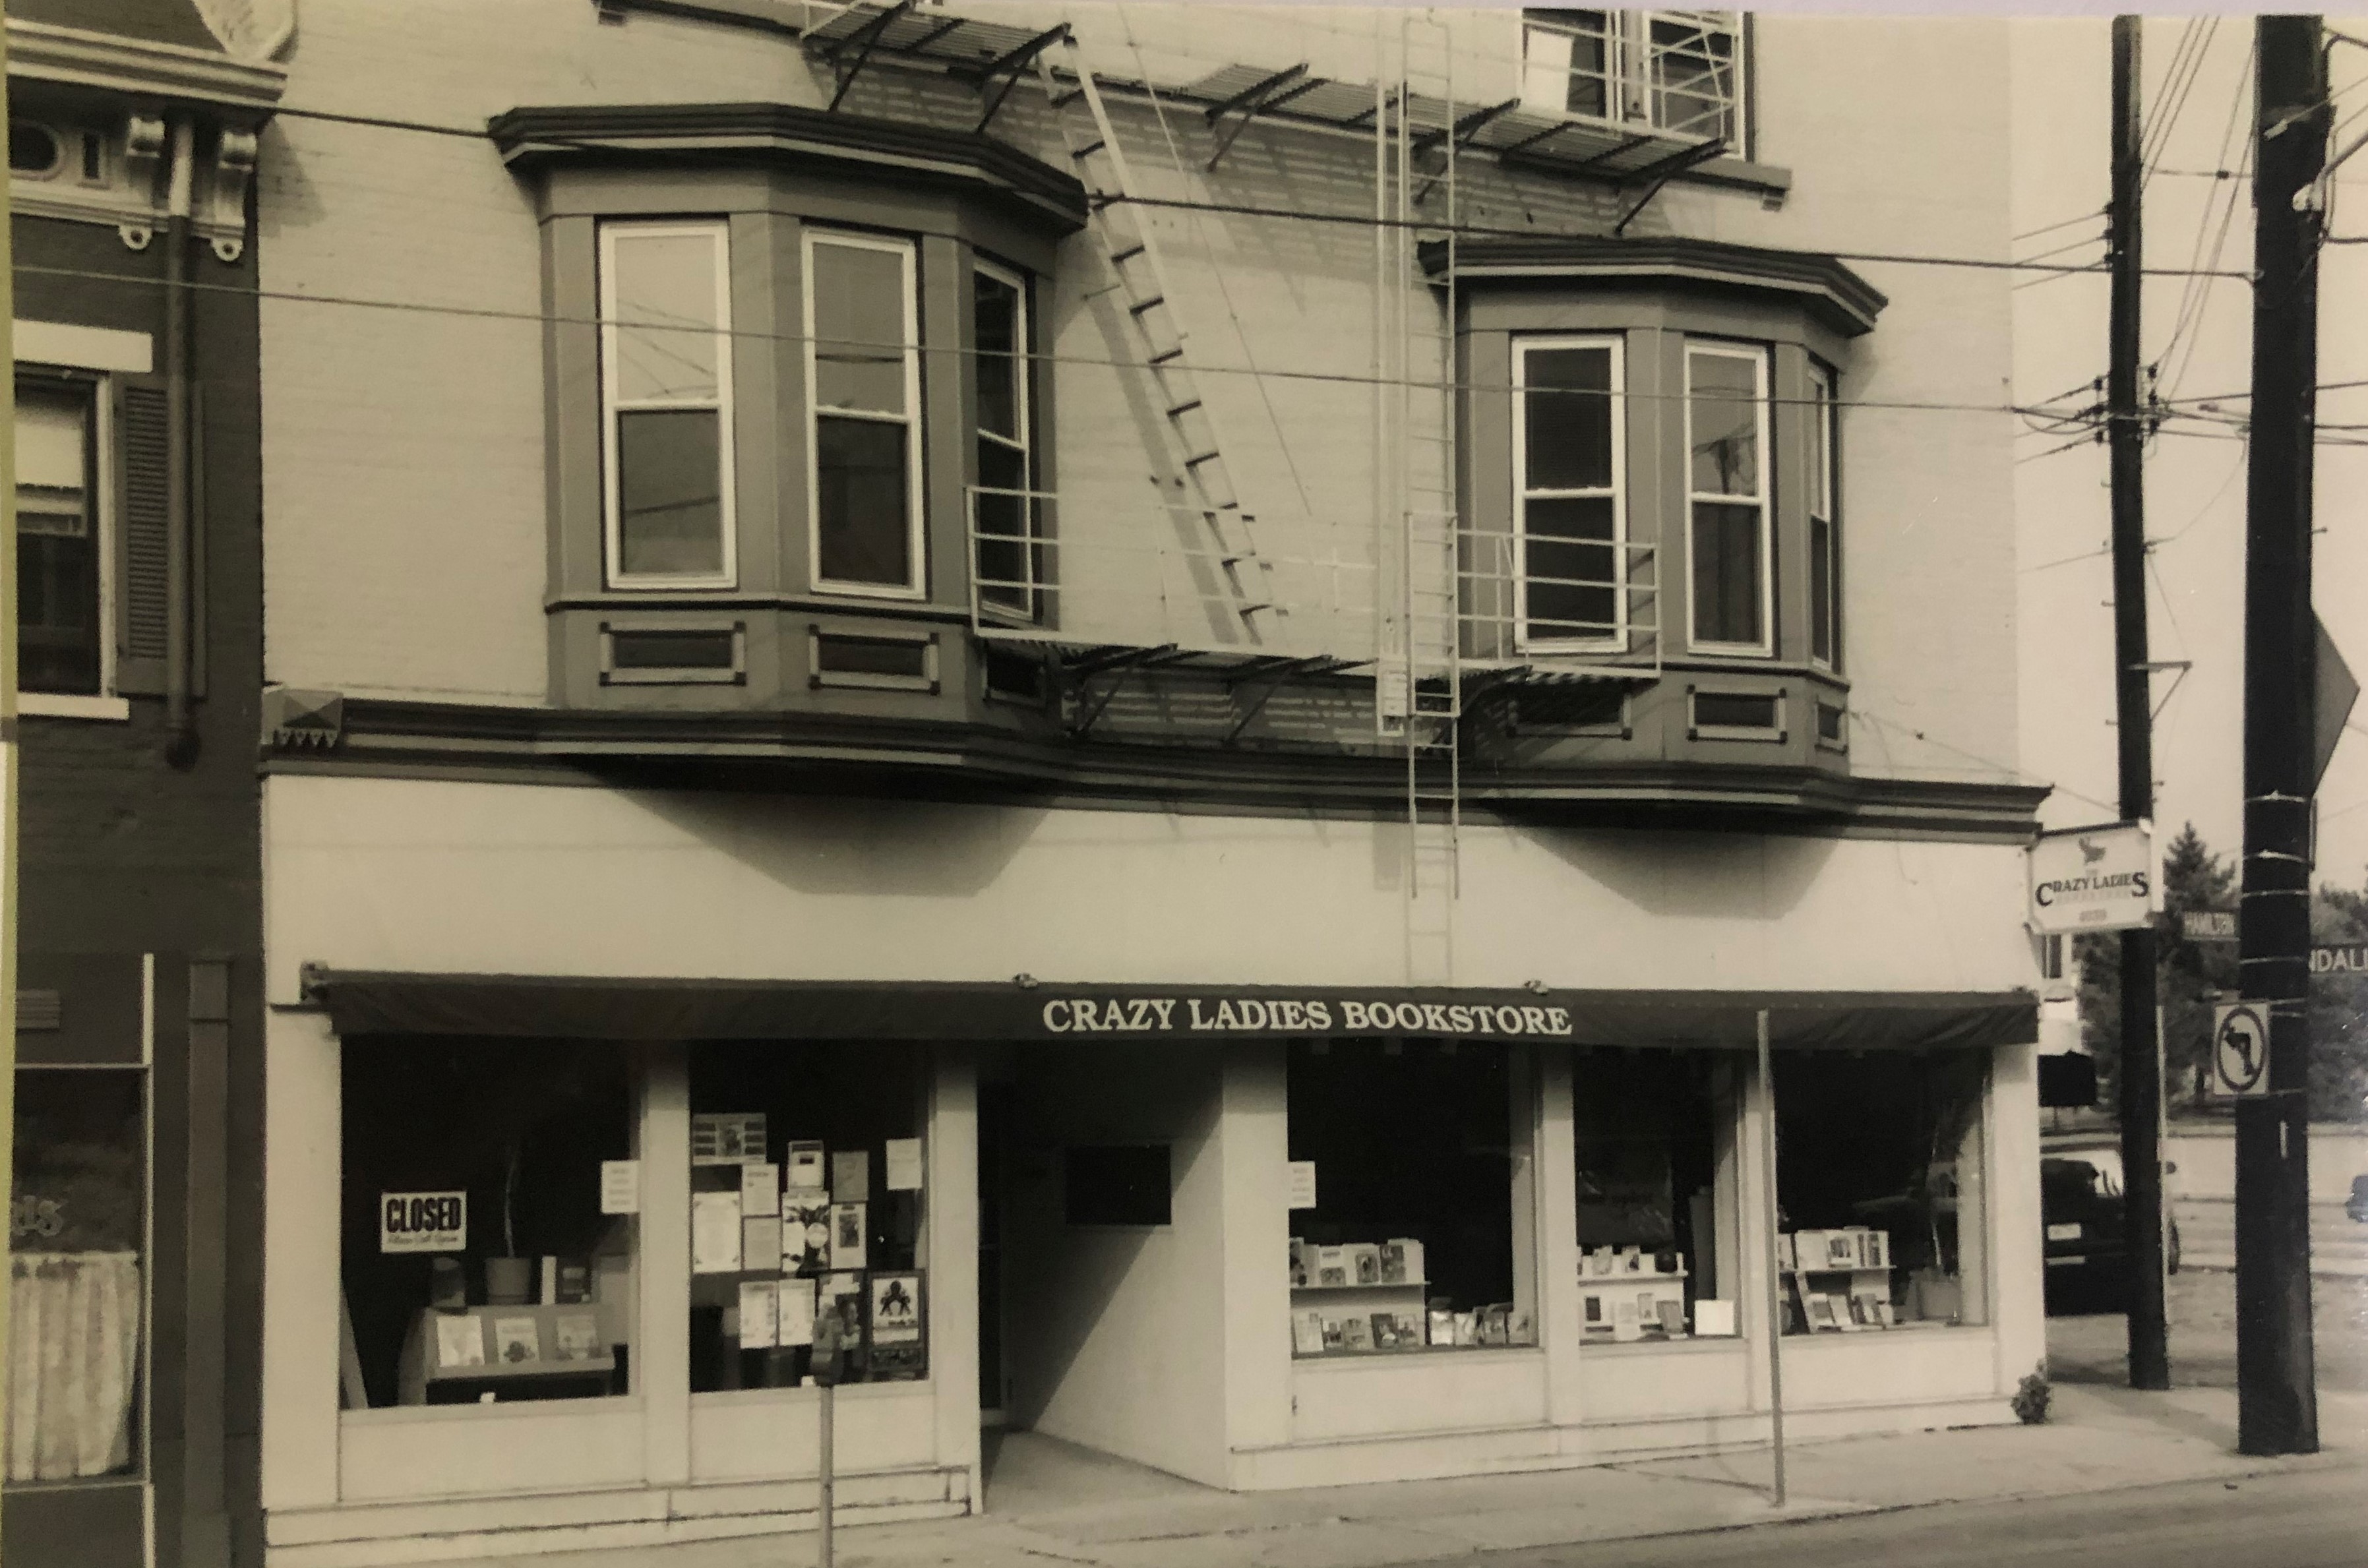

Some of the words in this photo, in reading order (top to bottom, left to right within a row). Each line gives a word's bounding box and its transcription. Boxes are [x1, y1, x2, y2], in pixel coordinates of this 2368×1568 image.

[2035, 878, 2089, 907] CRAZY
[2093, 872, 2149, 897] LADIES
[1043, 998, 1176, 1032] CRAZY
[1187, 998, 1333, 1031] LADIES
[1340, 1001, 1573, 1035] BOOKSTORE
[386, 1196, 461, 1233] CLOSED
